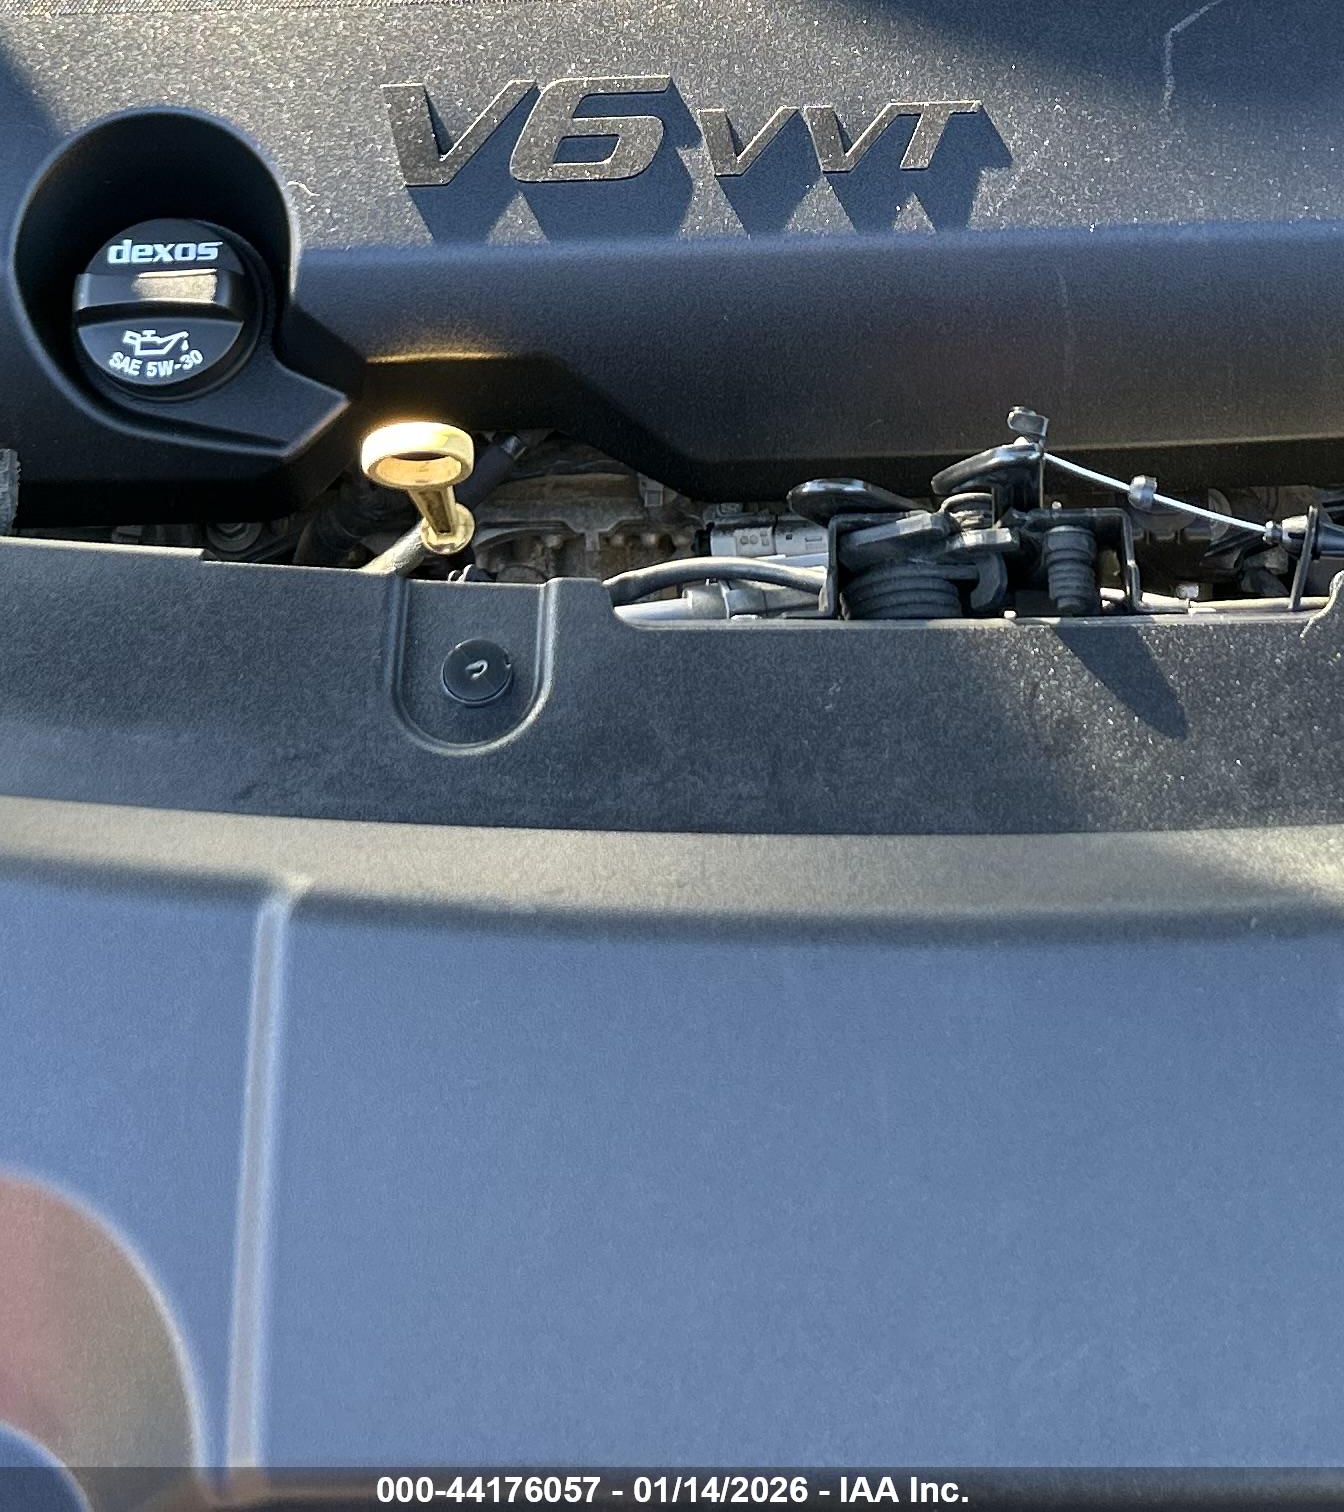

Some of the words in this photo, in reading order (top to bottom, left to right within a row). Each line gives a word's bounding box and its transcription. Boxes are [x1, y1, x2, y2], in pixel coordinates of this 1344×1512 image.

[380, 74, 671, 186] V6
[696, 100, 982, 176] VVT
[107, 239, 223, 264] dexos
[108, 351, 143, 377] SAE
[145, 349, 204, 377] 5W-30
